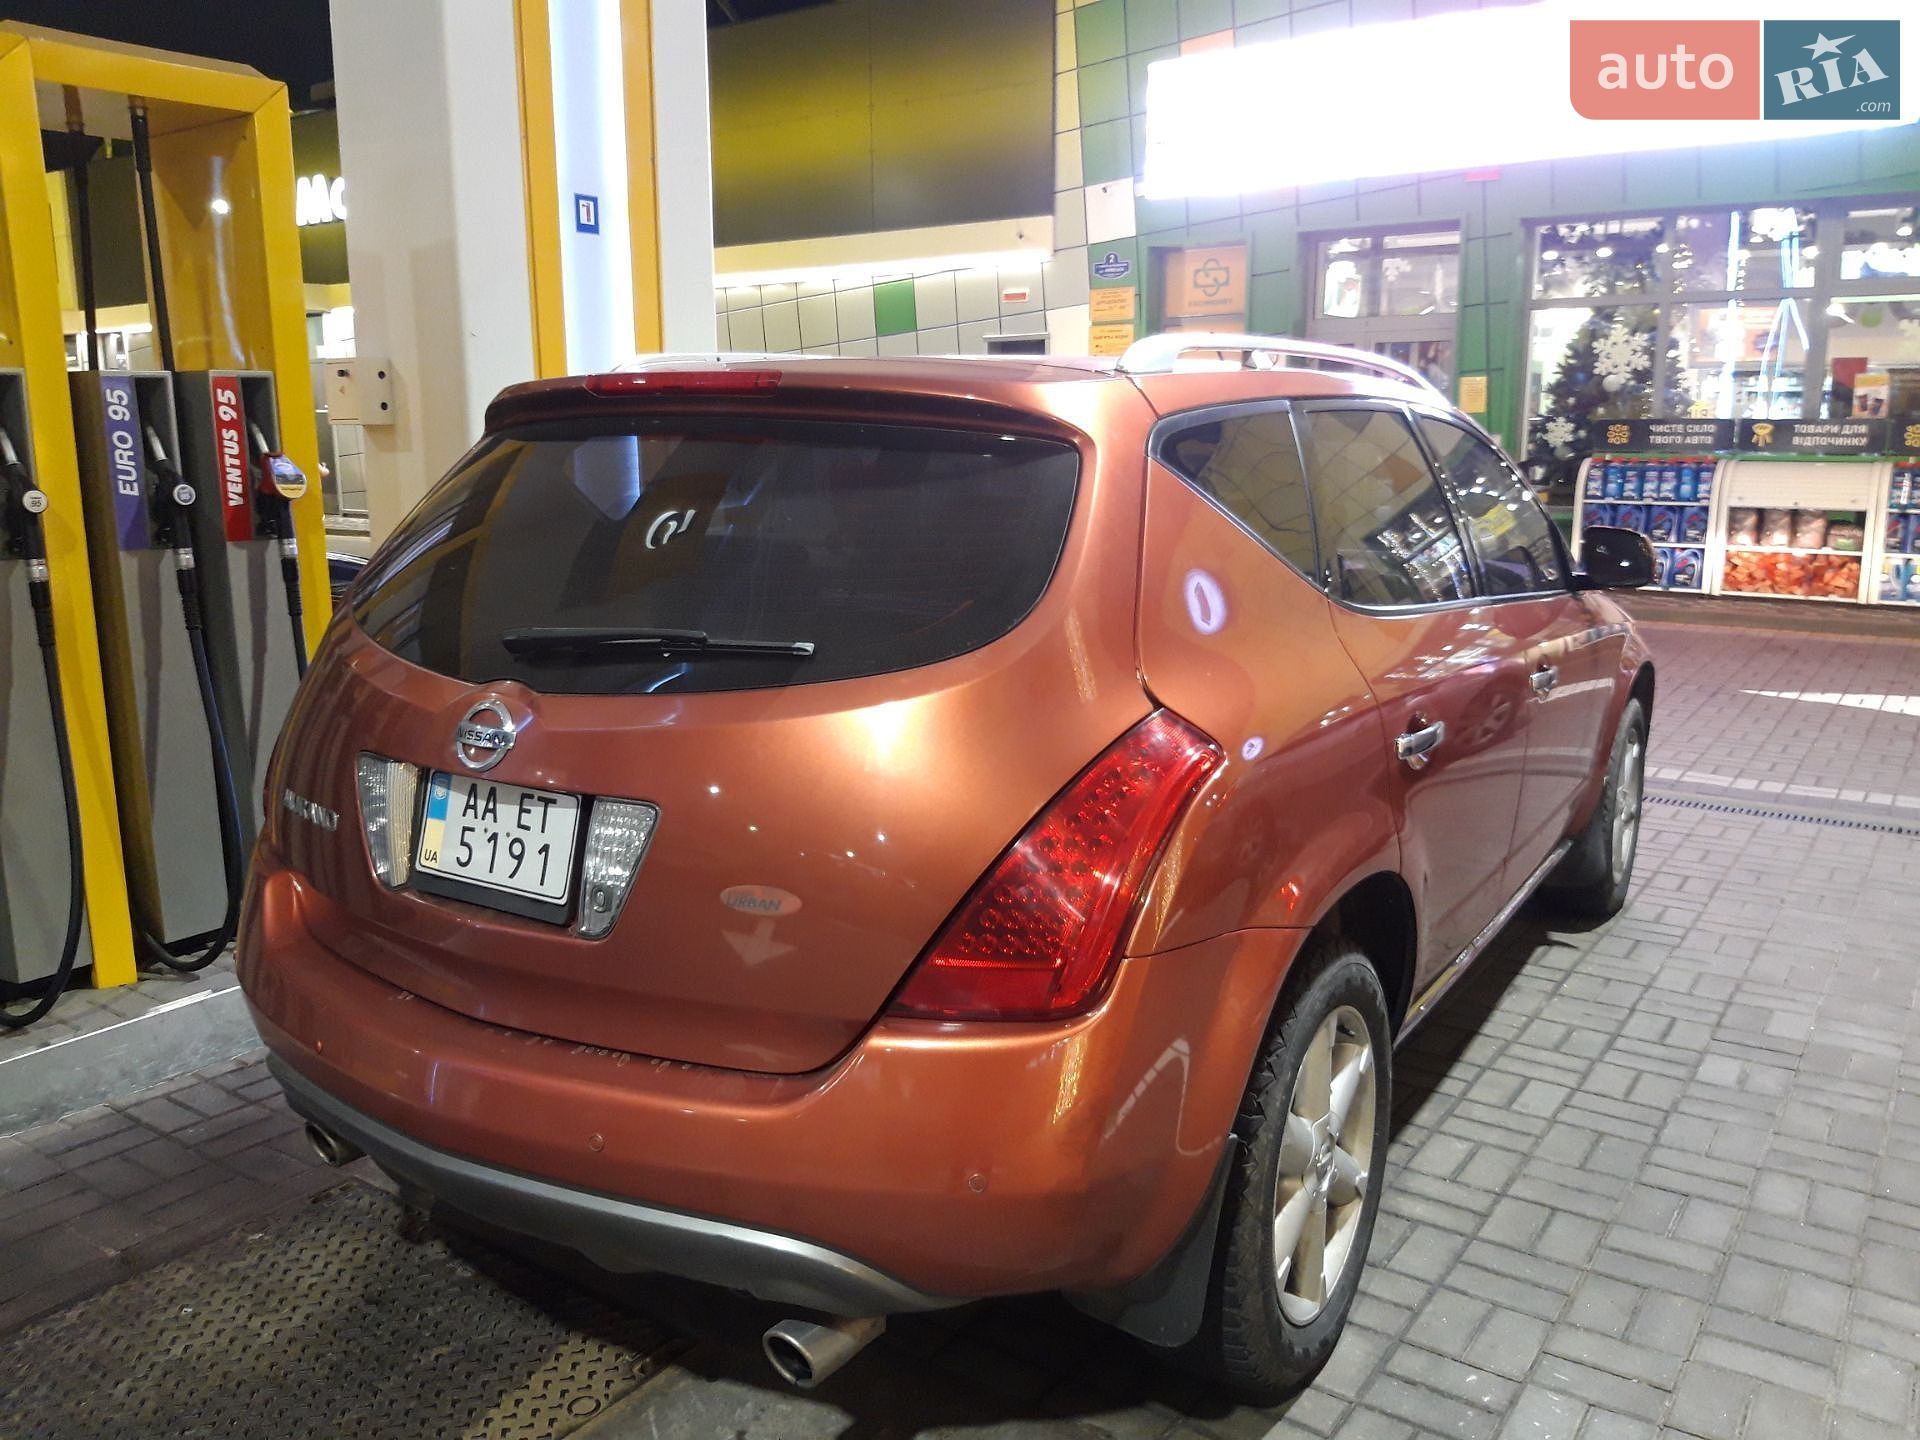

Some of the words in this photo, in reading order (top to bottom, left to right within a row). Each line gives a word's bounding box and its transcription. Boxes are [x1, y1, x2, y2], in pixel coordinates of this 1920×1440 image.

[105, 388, 131, 421] 95
[216, 388, 238, 422] 95
[1649, 424, 1684, 433] ЧИСТЕ
[1686, 424, 1715, 433] СКЛО
[1649, 435, 1681, 444] ТВОГО
[1684, 435, 1713, 444] АВТО
[1792, 436, 1868, 446] ВІДПОЧИНКУ
[1793, 424, 1839, 433] ТОВАРИ
[1841, 424, 1867, 434] ДЛЯ
[112, 430, 140, 496] EURO
[221, 428, 244, 507] VENTUS
[457, 726, 505, 746] NISSAN
[462, 783, 497, 823] AA
[517, 793, 557, 834] ET
[424, 849, 438, 864] UA
[456, 826, 551, 886] 5191
